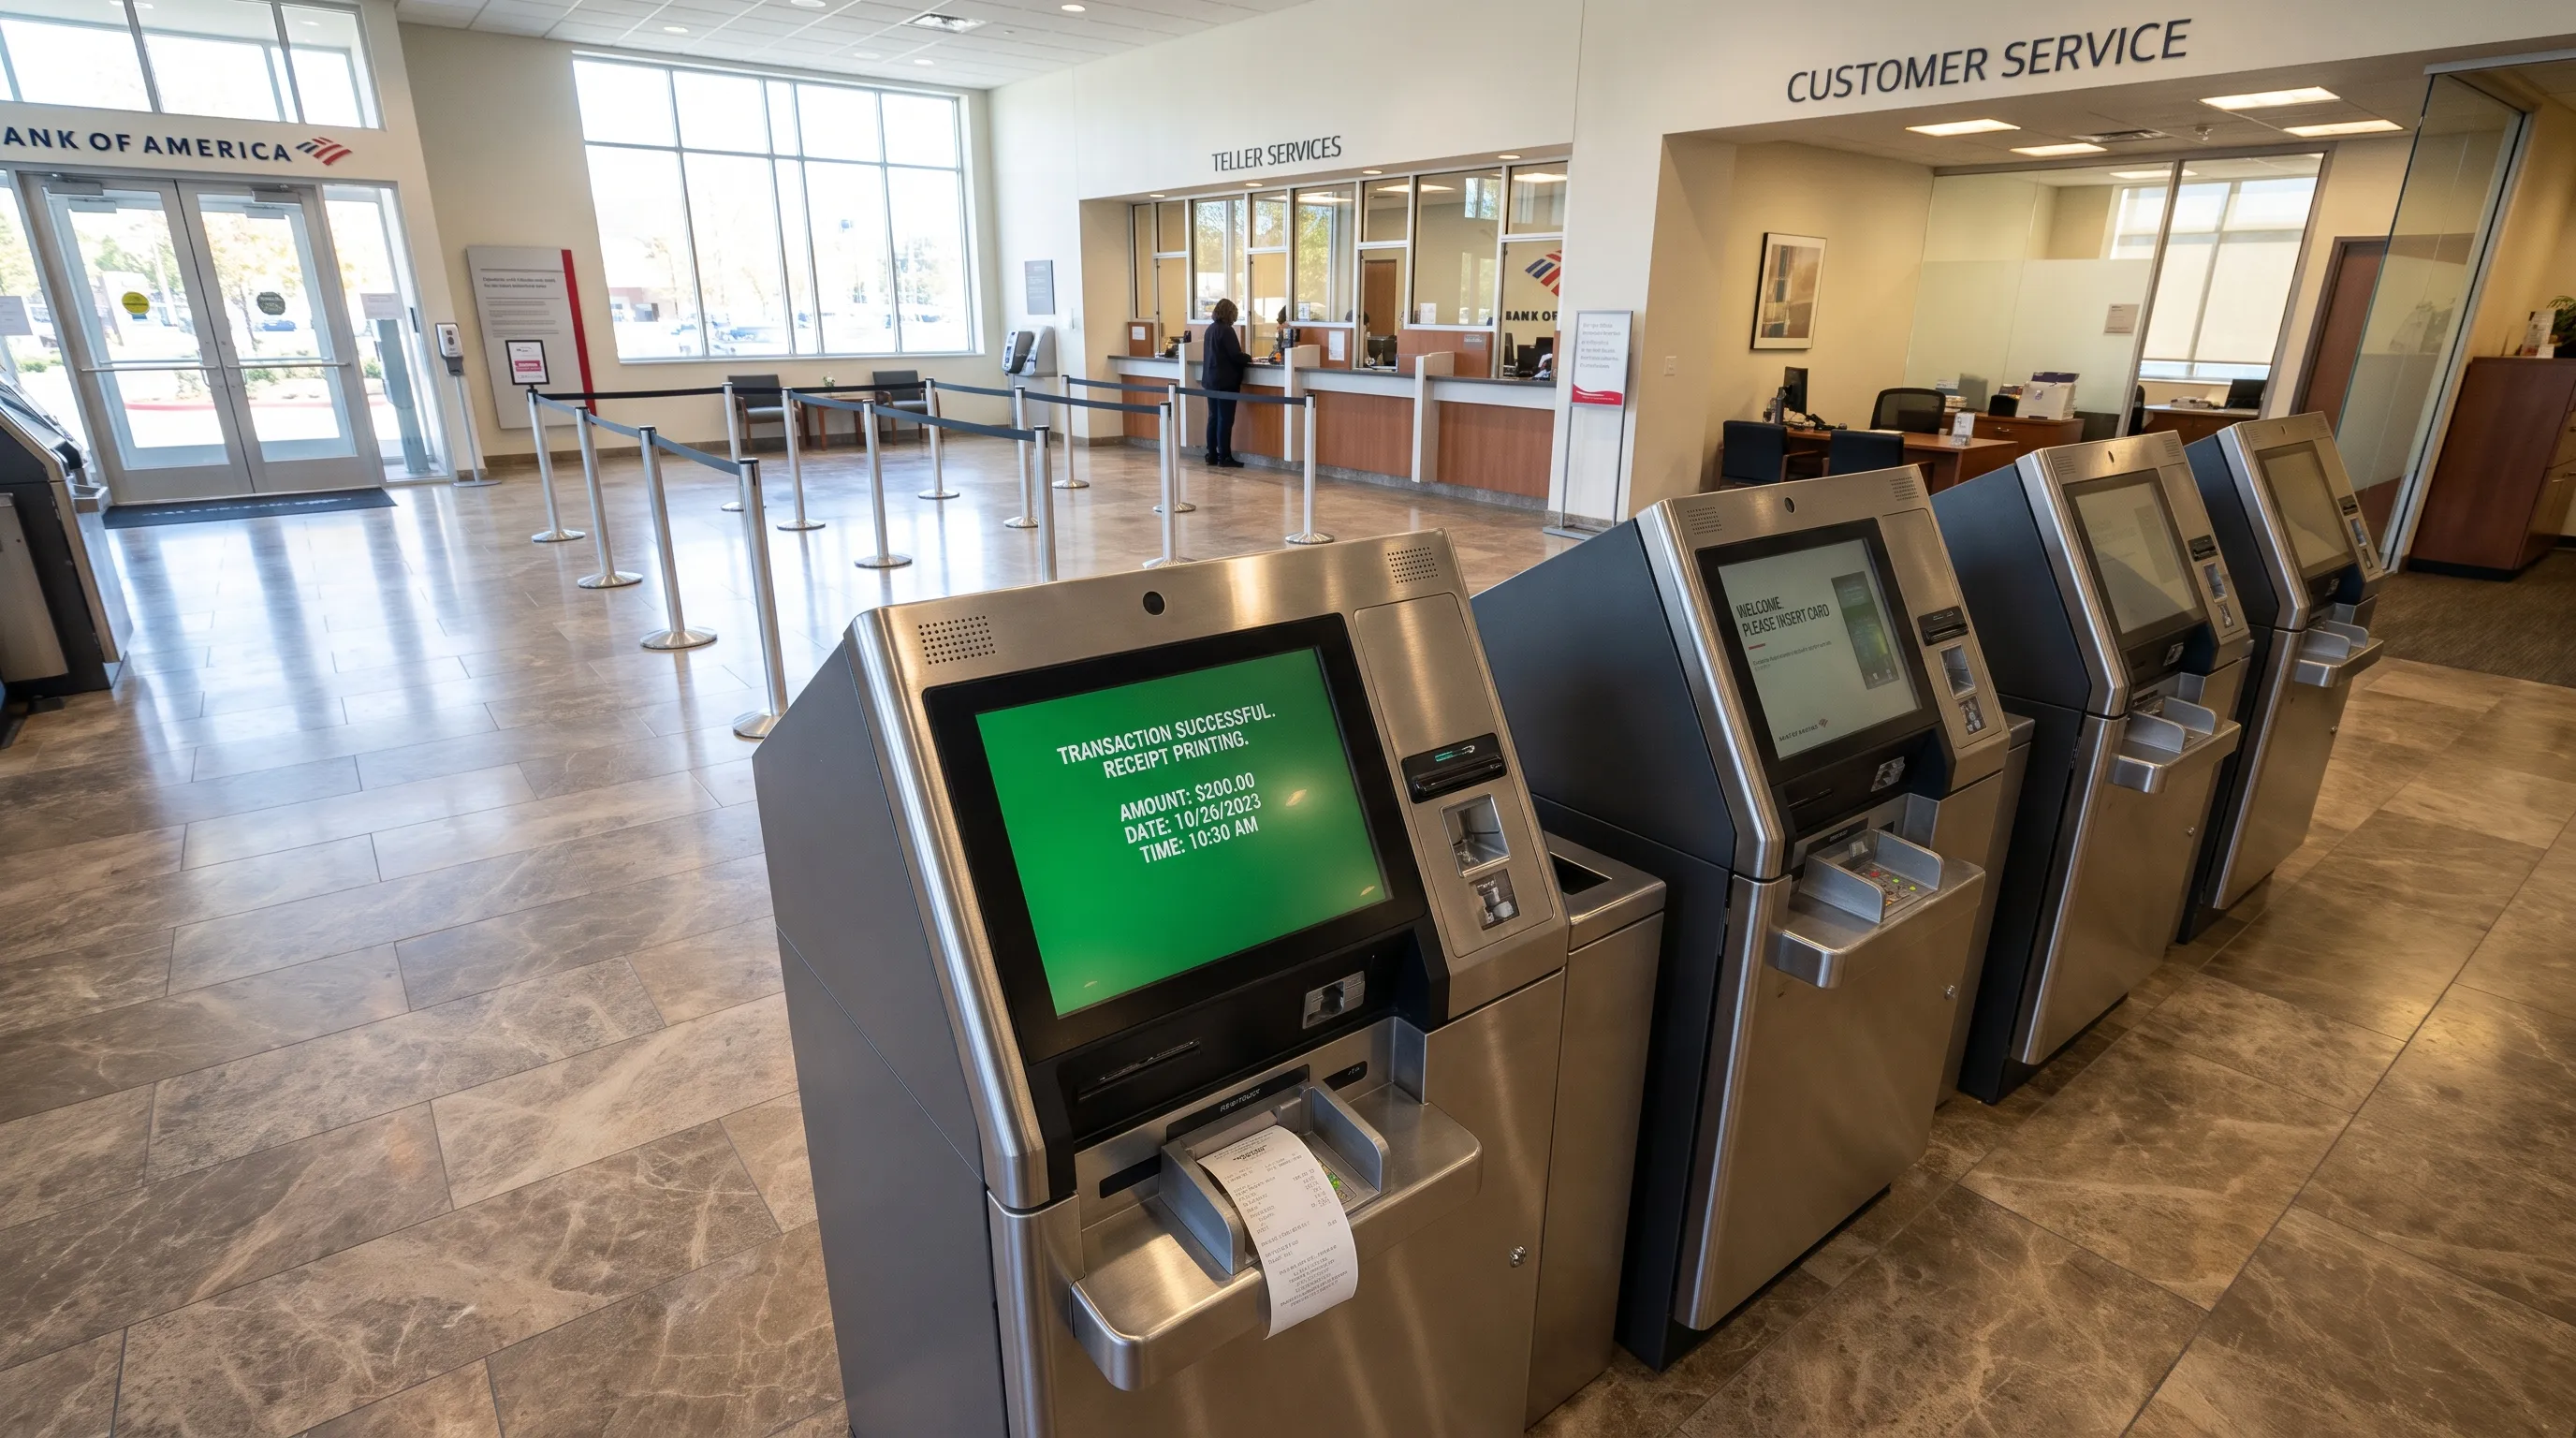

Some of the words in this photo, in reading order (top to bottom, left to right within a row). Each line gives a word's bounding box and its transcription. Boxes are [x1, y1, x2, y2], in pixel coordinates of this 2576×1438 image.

[1786, 47, 1988, 103] CUSTOMER
[2001, 18, 2192, 78] SERVICE
[4, 126, 80, 150] ANK
[88, 132, 130, 152] OF
[143, 136, 292, 162] AMERICA
[1211, 147, 1263, 171] TELLER
[1267, 135, 1342, 166] SERVICES
[1505, 311, 1538, 321] BANK
[1742, 616, 1777, 637] PLEASE
[1057, 725, 1172, 764] TRANSACTION
[1175, 703, 1276, 739] SUCCESSFUL.
[1103, 748, 1168, 778] RECEIPT
[1173, 731, 1249, 762] PRINTING.
[1120, 788, 1193, 822] AMOUNT:
[1195, 772, 1255, 802] $200.00
[1124, 817, 1171, 844] DATE:
[1174, 793, 1262, 830] 10/26/2023
[1139, 838, 1185, 863] TIME:
[1189, 823, 1230, 850] 10:30
[1235, 815, 1259, 837] AM
